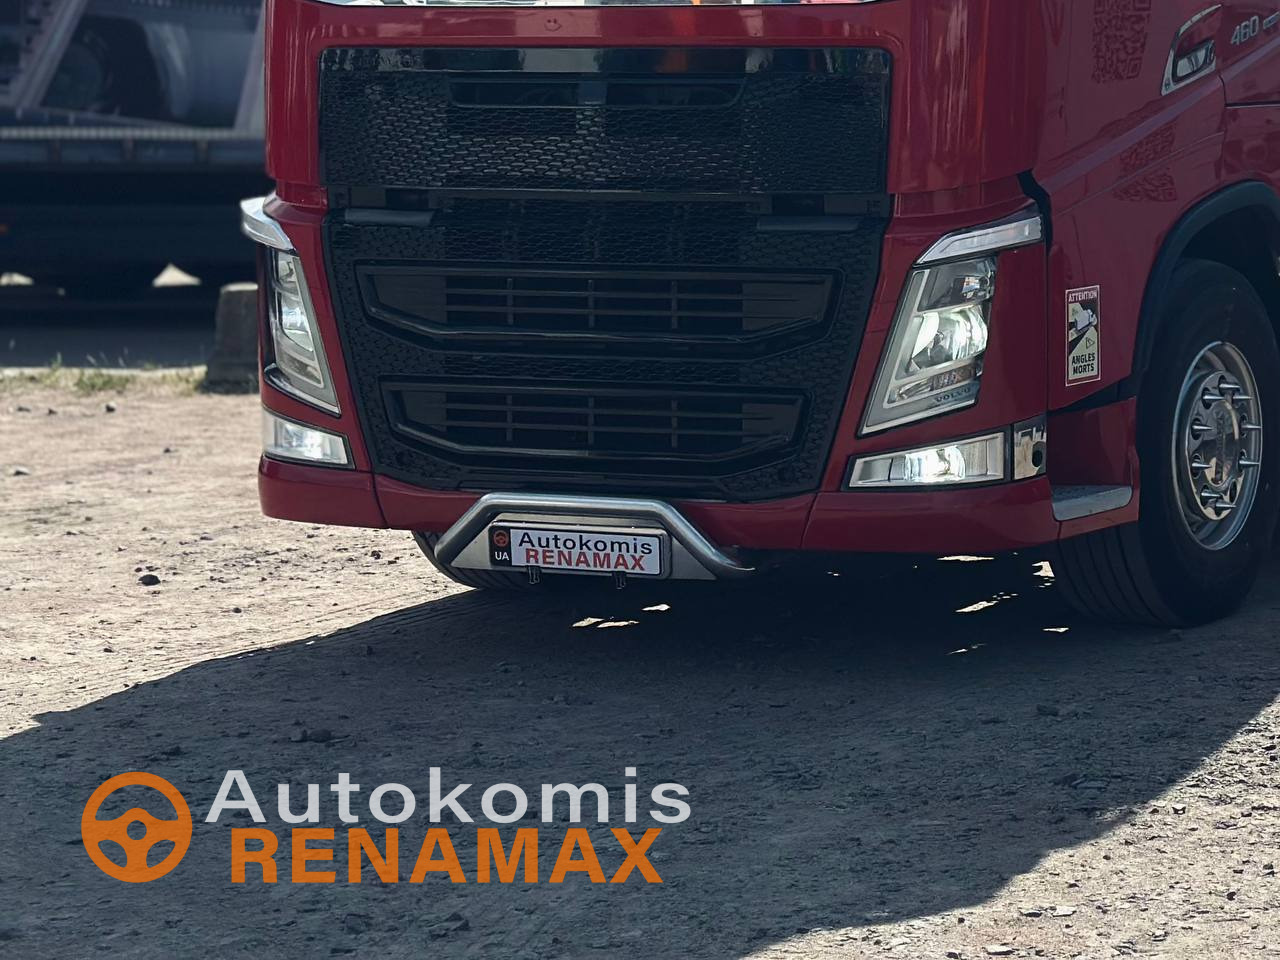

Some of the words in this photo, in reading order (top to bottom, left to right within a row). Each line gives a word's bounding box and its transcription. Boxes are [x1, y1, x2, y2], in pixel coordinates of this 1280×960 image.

[1231, 15, 1259, 45] 460
[1068, 290, 1098, 302] ATTENTION
[1071, 352, 1096, 366] ANGLES
[1072, 362, 1095, 375] MORTS
[518, 531, 653, 556] Autokomis
[495, 551, 510, 562] UA
[525, 548, 646, 572] RENAMAX
